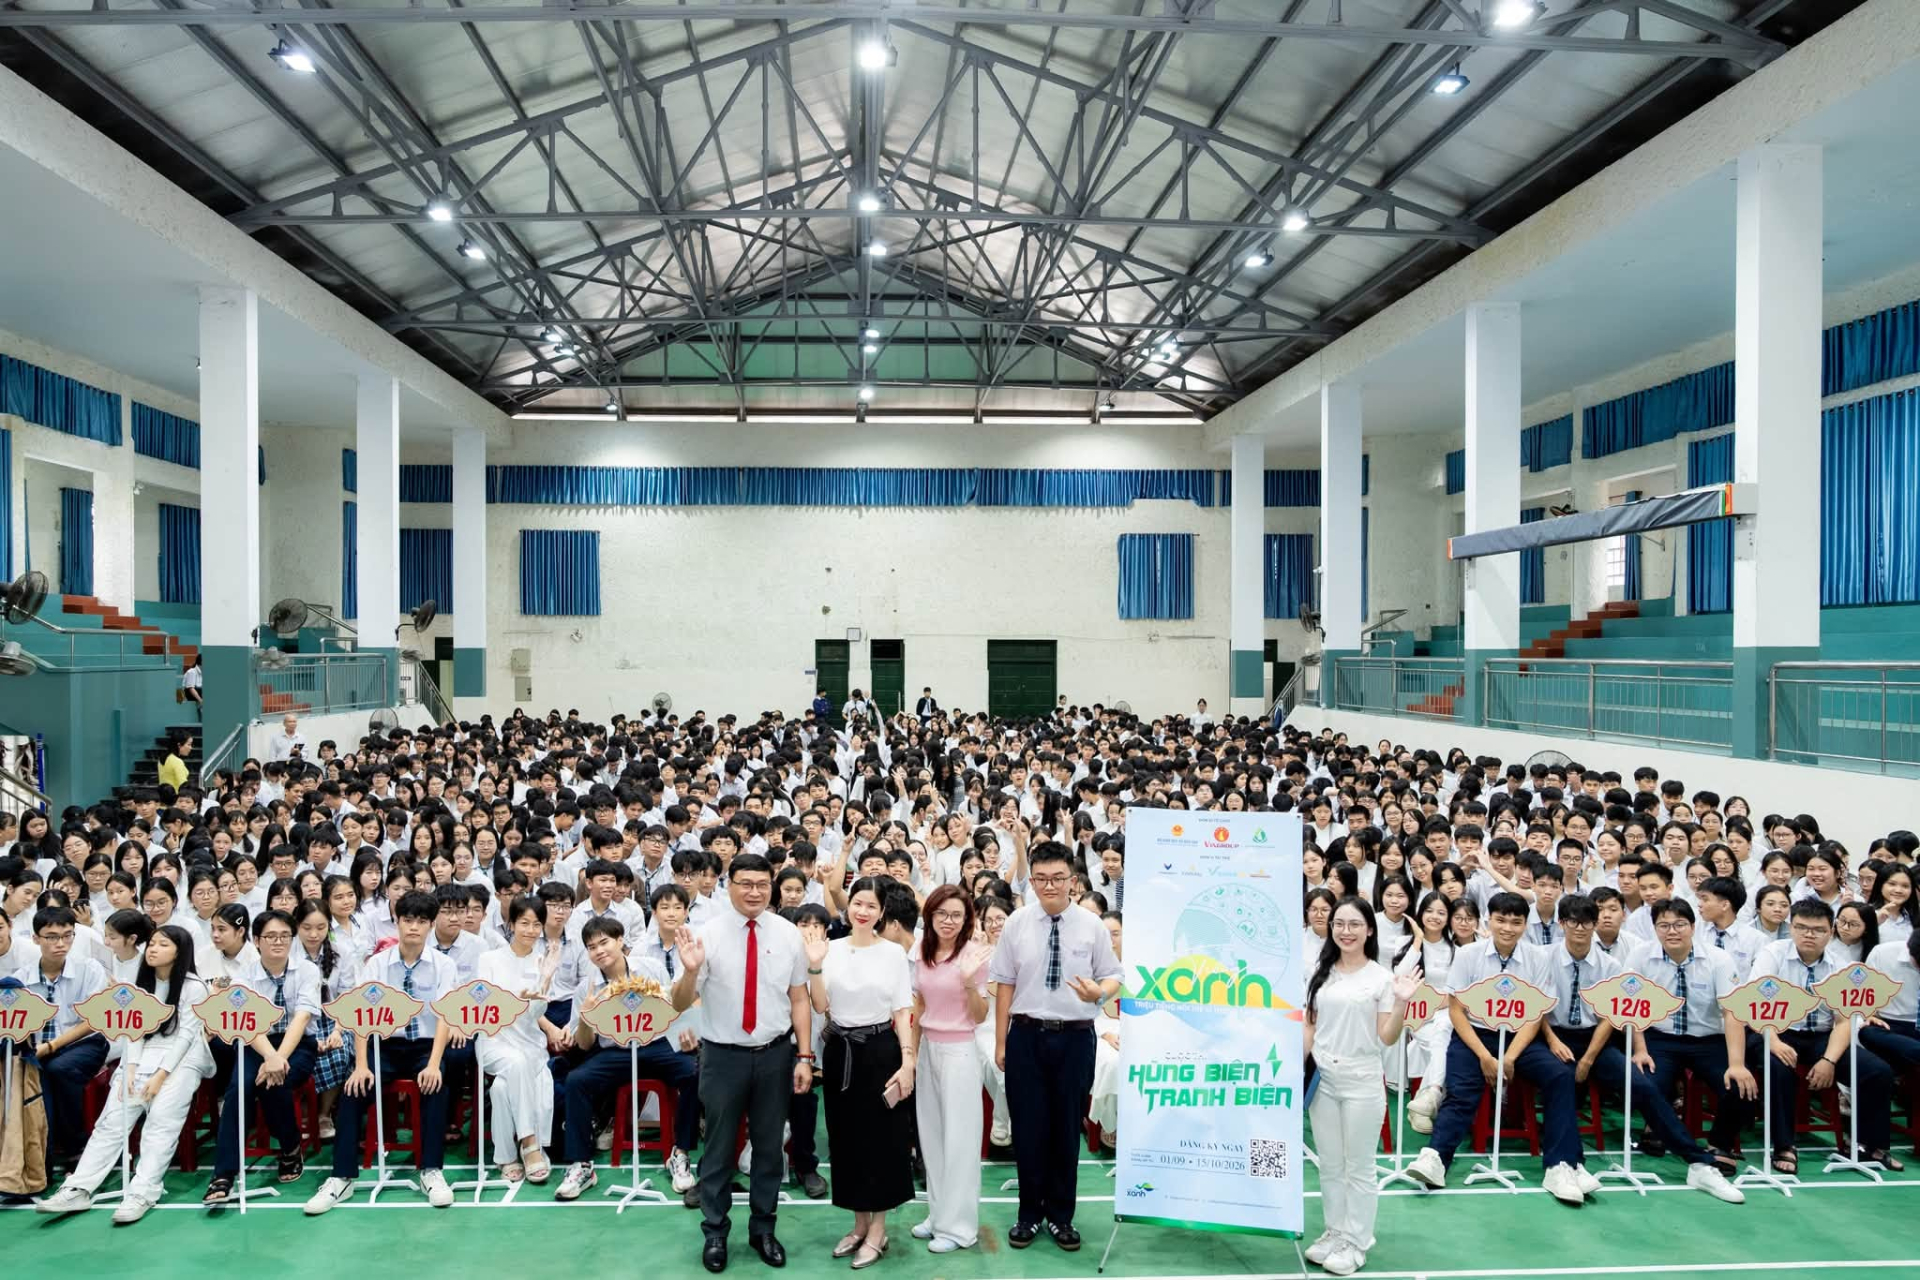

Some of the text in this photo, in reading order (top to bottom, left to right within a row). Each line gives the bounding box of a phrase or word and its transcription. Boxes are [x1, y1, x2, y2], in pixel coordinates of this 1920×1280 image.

[1611, 996, 1651, 1019] 12/8
[1841, 989, 1875, 1007] 12/6
[355, 1007, 395, 1027] 11/4
[460, 1005, 500, 1025] 11/3
[1404, 1000, 1428, 1020] /10
[1485, 998, 1526, 1019] 12/9
[1749, 1000, 1789, 1020] 12/7
[0, 1009, 28, 1029] 1/7
[104, 1009, 143, 1030] 11/6
[220, 1011, 256, 1032] 11/5
[613, 1012, 653, 1033] 11/2
[1144, 1087, 1226, 1115] TRANH
[1160, 1154, 1186, 1167] 01/09
[1196, 1158, 1246, 1171] 15/10/2026
